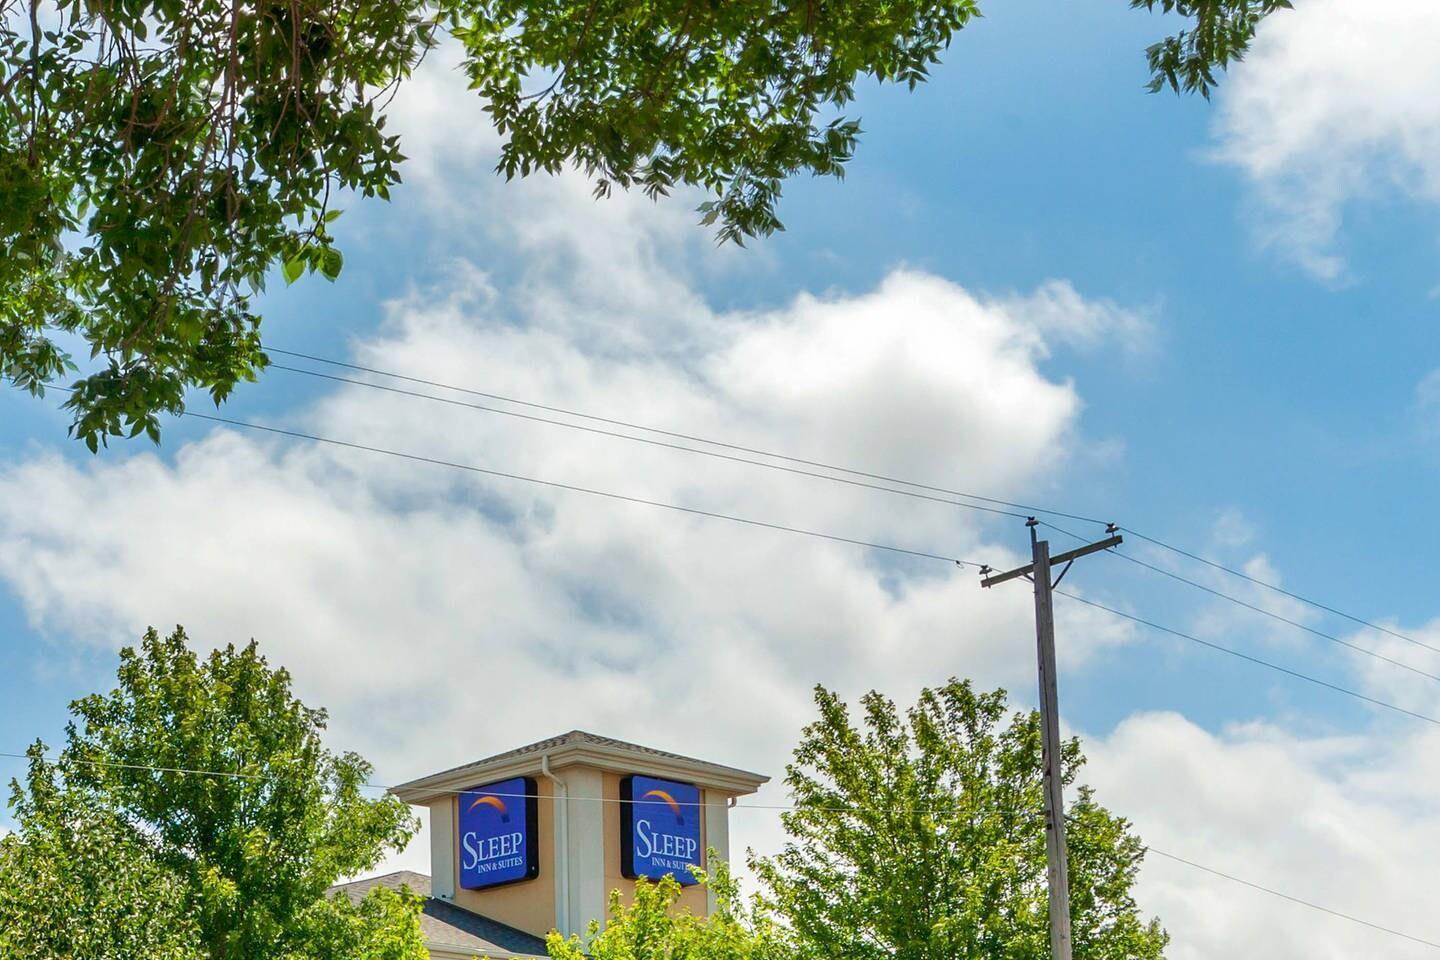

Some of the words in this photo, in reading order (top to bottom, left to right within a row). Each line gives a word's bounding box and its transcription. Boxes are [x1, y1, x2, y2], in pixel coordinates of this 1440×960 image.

[462, 831, 523, 870] SLEEP
[636, 819, 697, 859] SLEEP
[477, 864, 492, 873] INN
[498, 856, 523, 870] SUITES
[652, 857, 666, 867] INN
